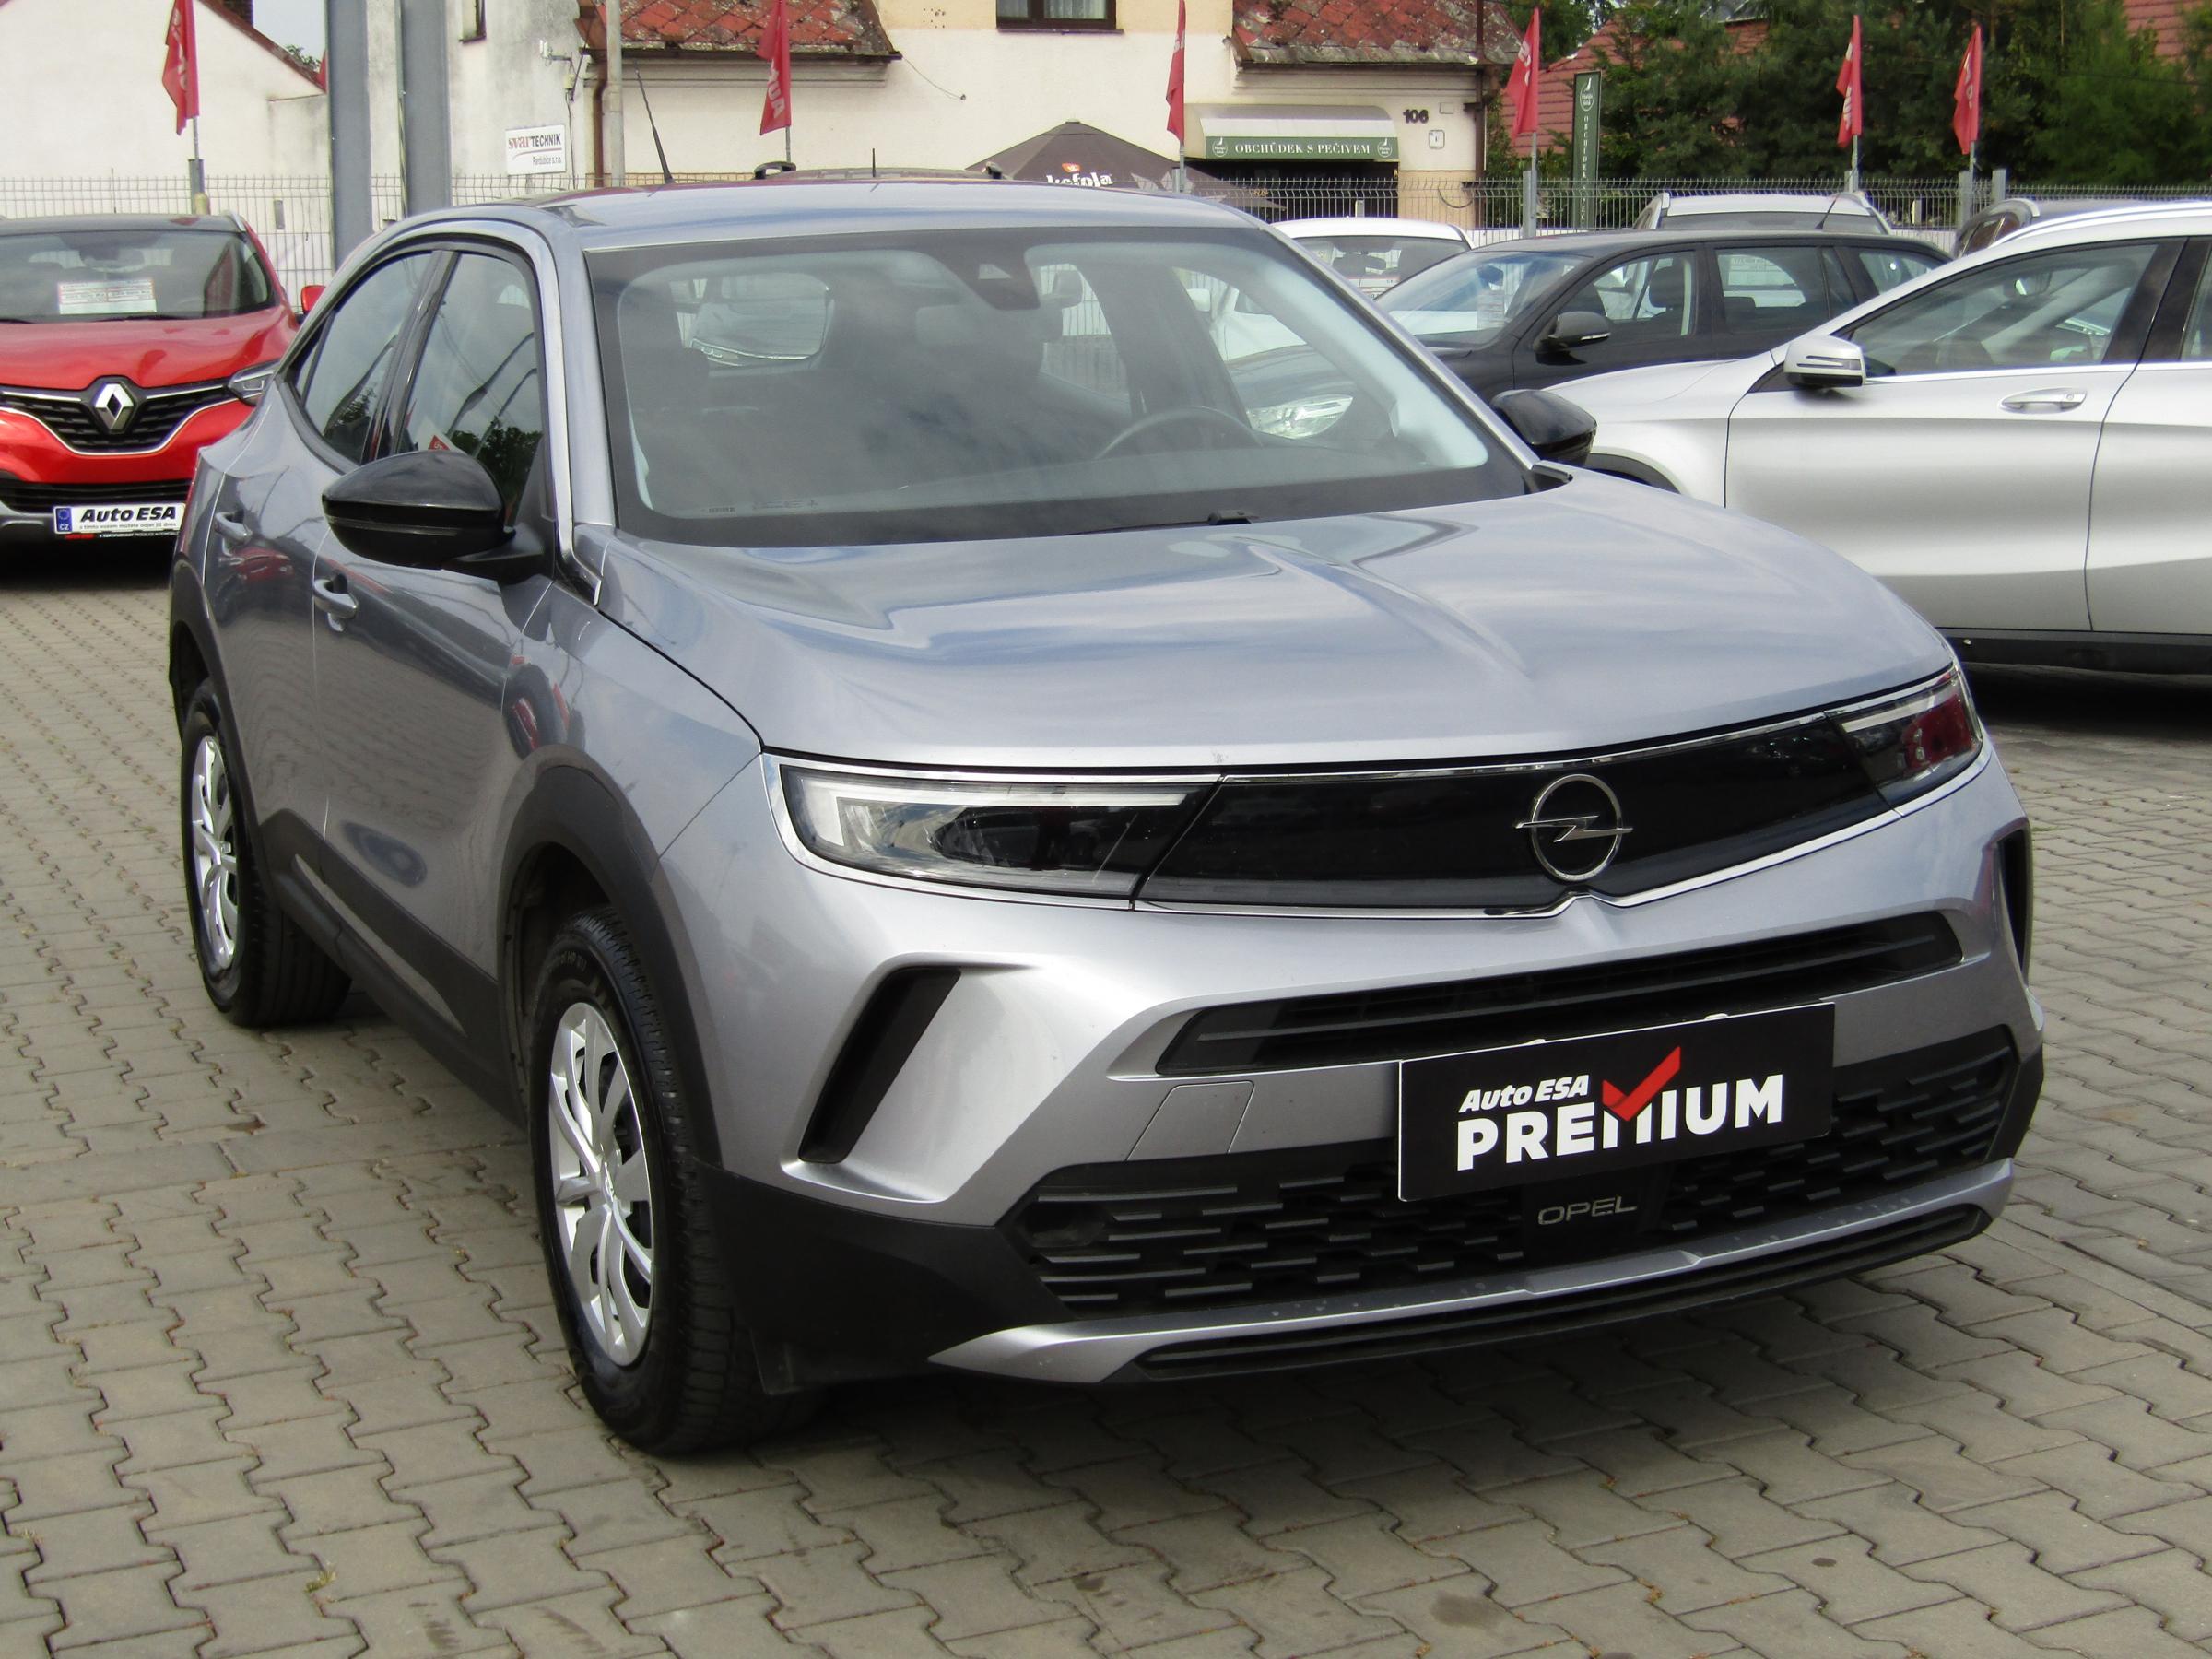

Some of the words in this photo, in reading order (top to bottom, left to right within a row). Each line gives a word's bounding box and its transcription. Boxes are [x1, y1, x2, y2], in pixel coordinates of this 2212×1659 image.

[1403, 109, 1429, 124] 106
[1235, 142, 1303, 154] OBCHŮDEK
[1307, 144, 1313, 154] S
[1318, 142, 1370, 154] PEČIVEM
[80, 508, 134, 522] Auto
[136, 506, 176, 521] ESA
[1458, 1083, 1533, 1113] Auto
[1534, 1074, 1589, 1102] ESA
[1456, 1073, 1783, 1171] PREMIUM
[1536, 1194, 1638, 1226] OPEL
